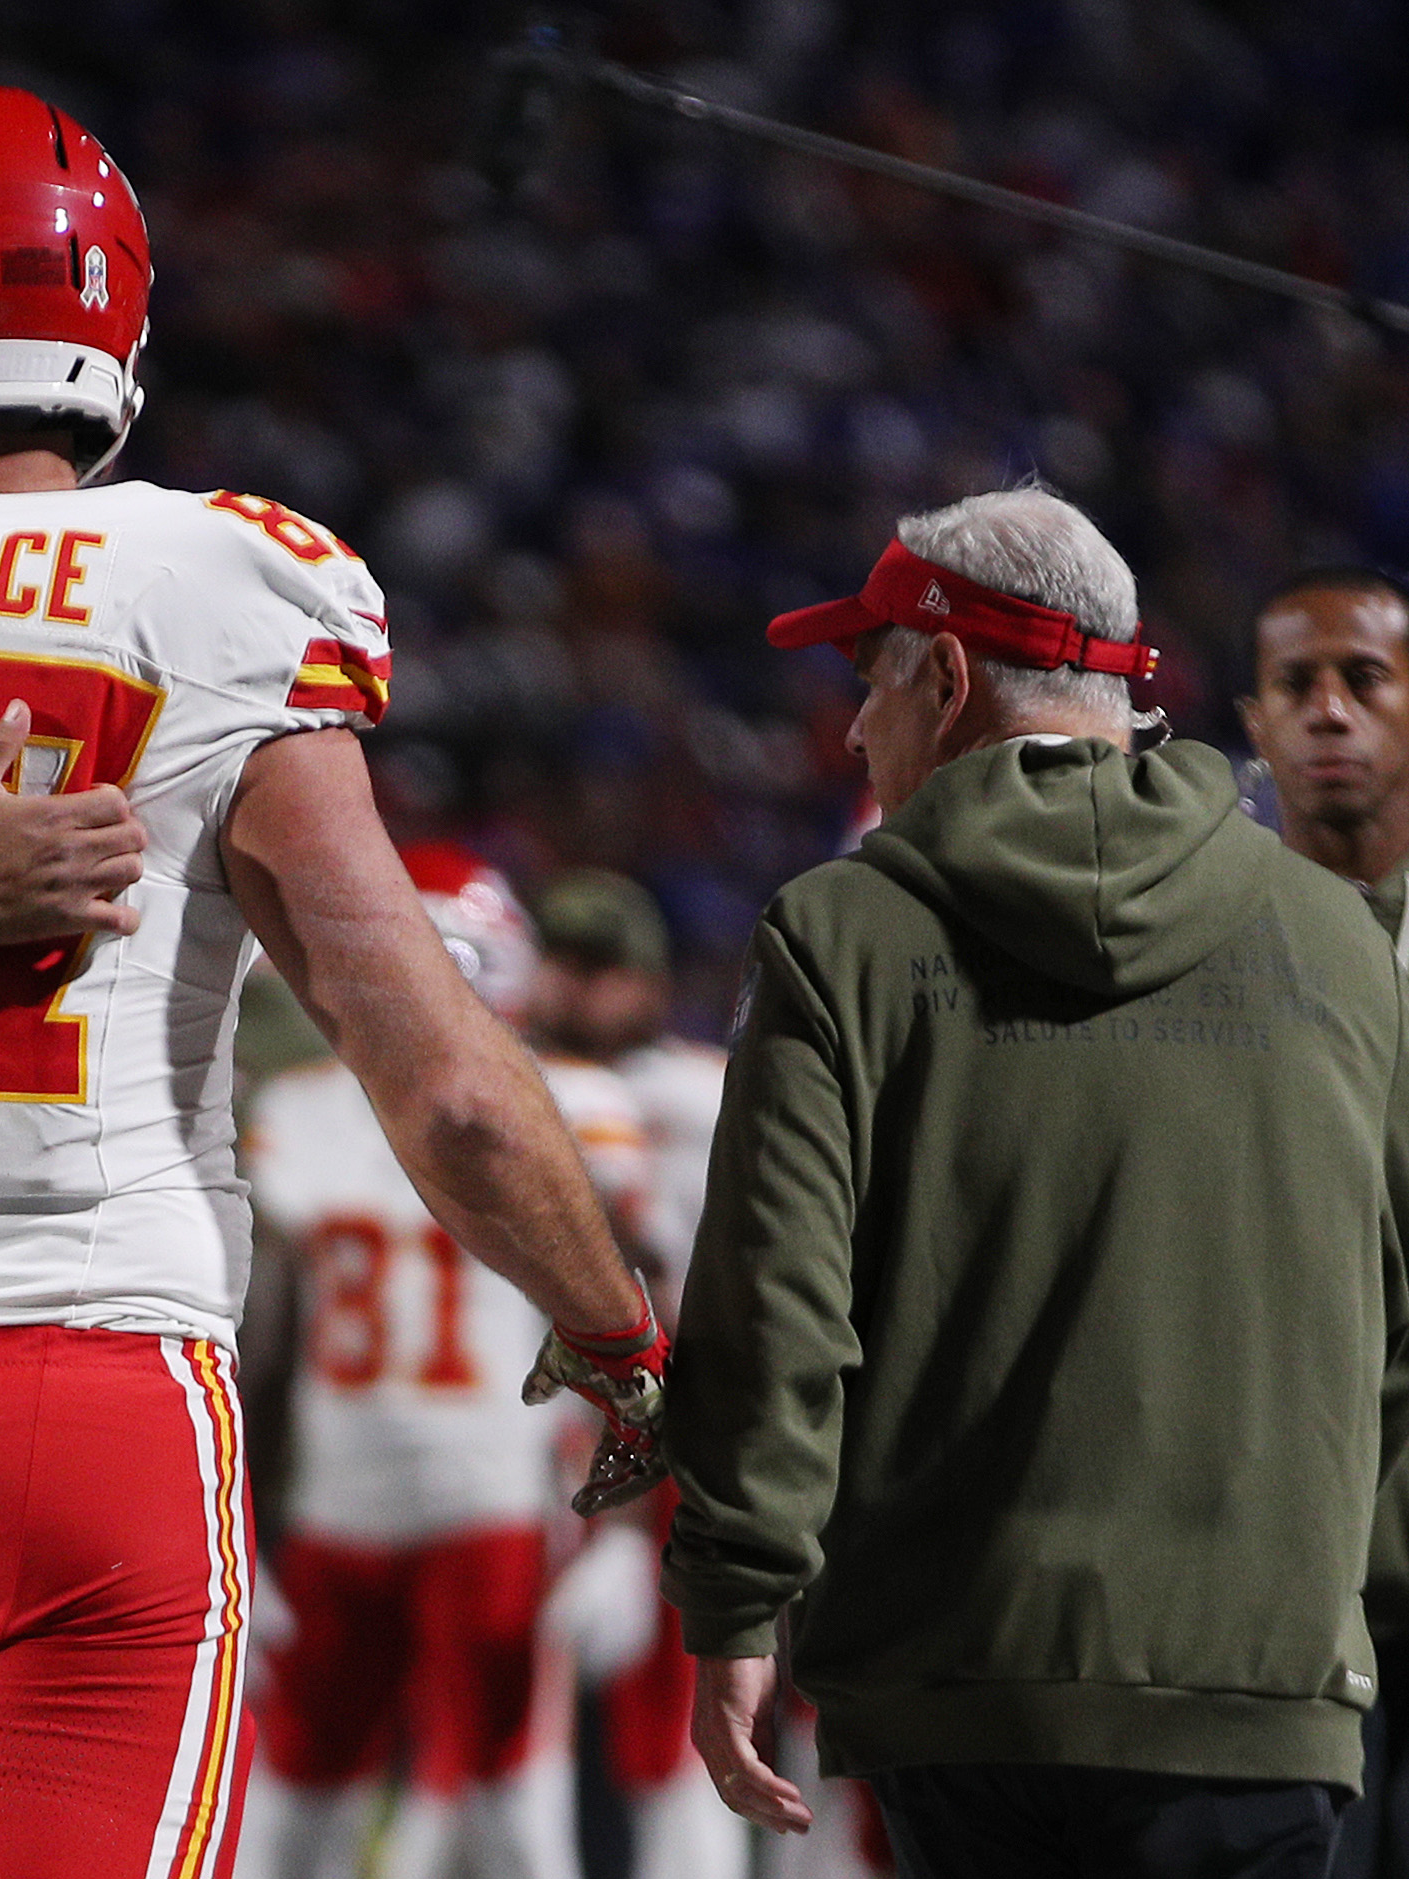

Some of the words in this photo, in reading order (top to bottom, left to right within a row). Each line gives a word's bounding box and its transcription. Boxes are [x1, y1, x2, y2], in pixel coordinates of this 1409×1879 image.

[203, 489, 368, 567] 8
[984, 1019, 1093, 1046] SALUTE
[1109, 1020, 1139, 1043] TO
[1153, 1018, 1271, 1051] SERVICE
